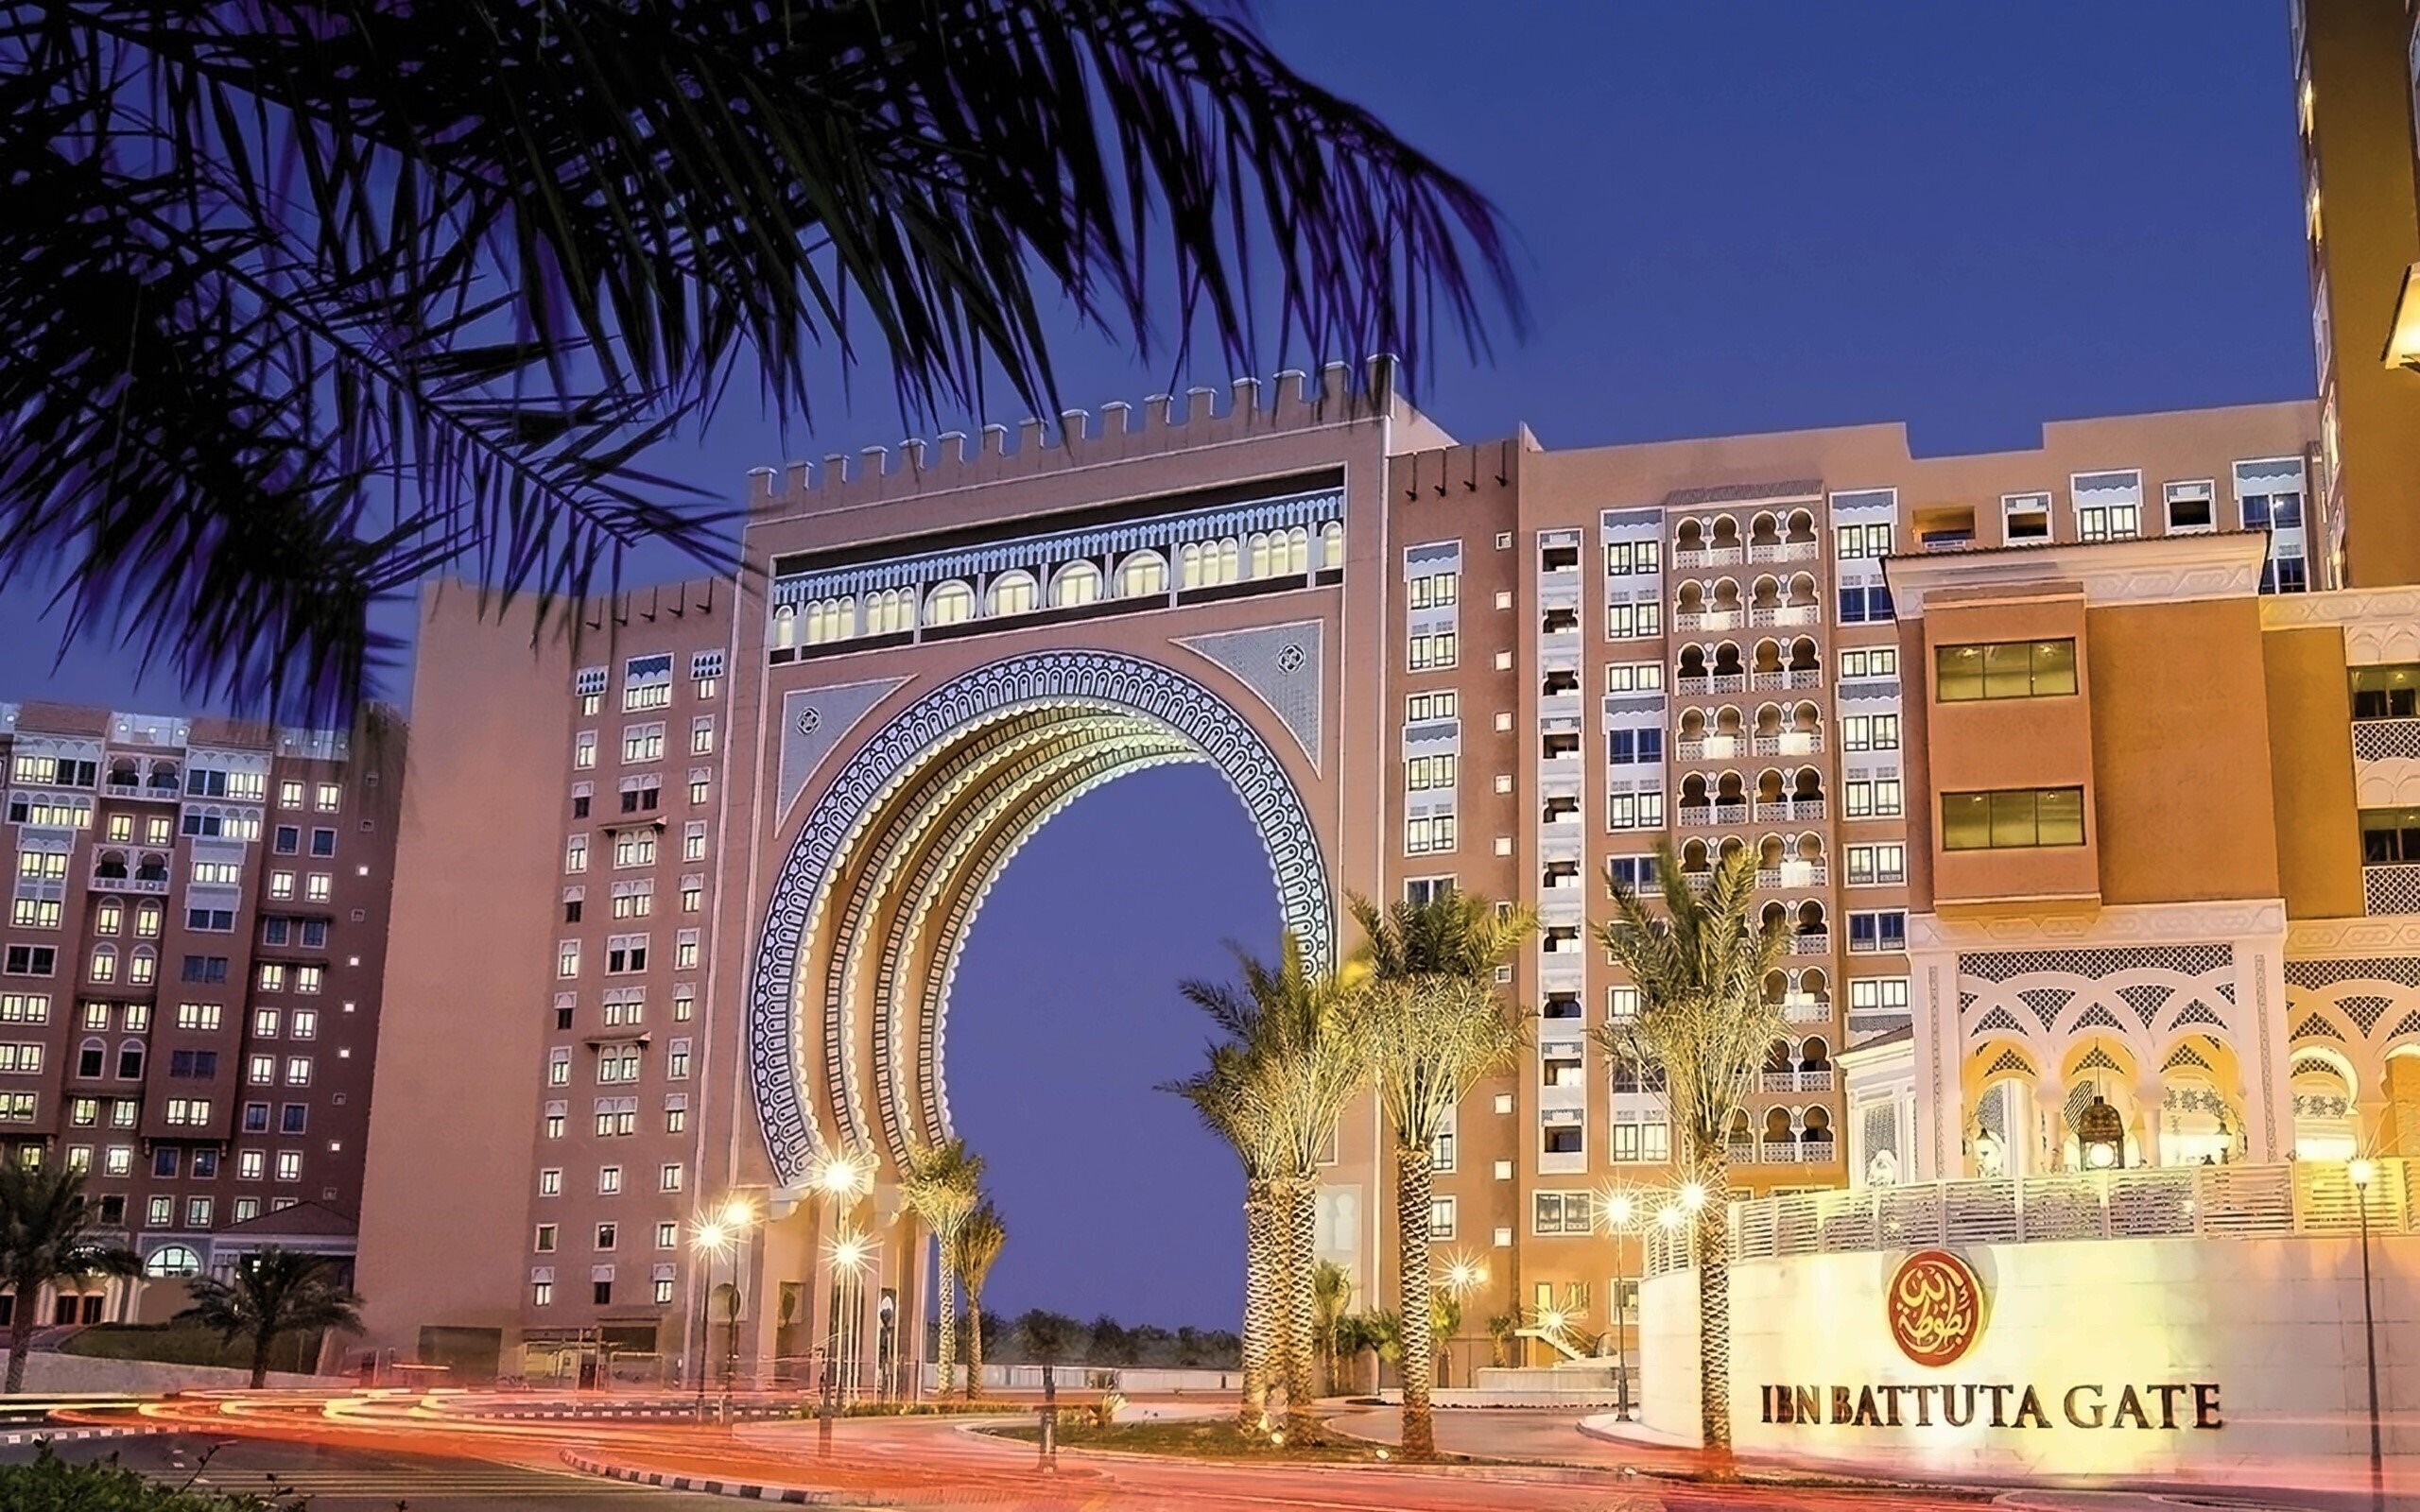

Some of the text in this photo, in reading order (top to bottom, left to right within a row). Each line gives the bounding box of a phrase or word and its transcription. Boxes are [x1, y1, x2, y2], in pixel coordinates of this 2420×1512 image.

[1760, 1383, 2223, 1429] IBN BATTUTA GATE
